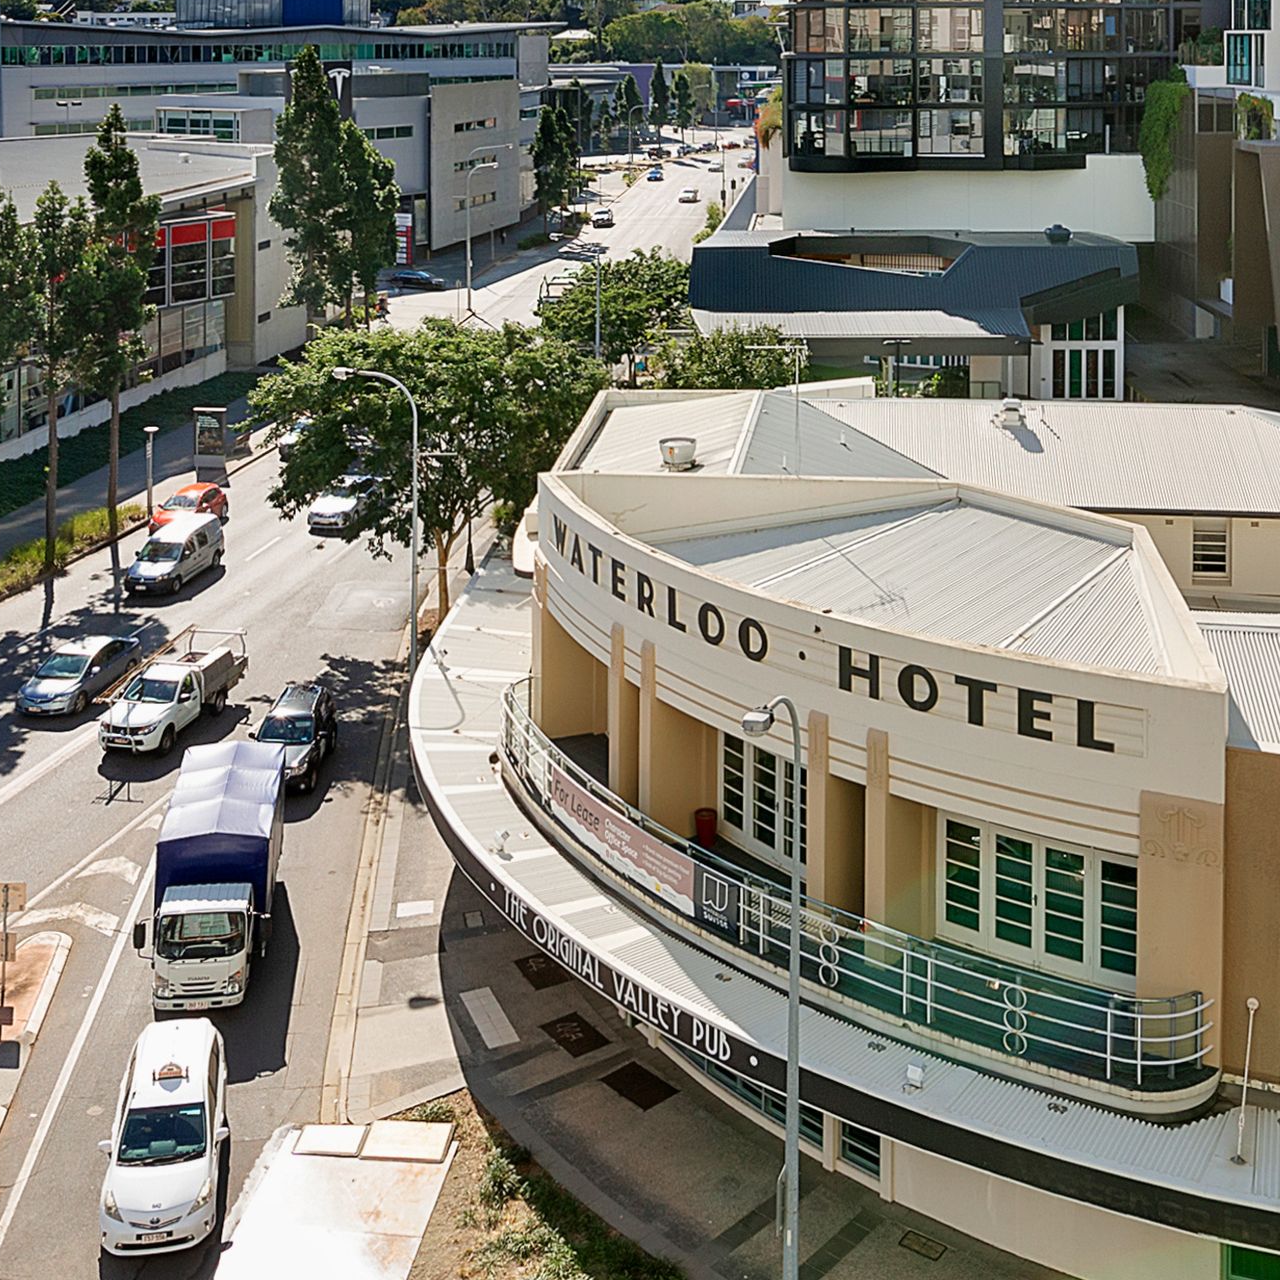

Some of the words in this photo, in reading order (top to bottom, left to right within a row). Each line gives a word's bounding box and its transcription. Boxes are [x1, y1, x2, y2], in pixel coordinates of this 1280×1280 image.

[551, 513, 768, 662] WATERLOO
[838, 646, 1115, 753] HOTEL
[554, 778, 570, 805] For
[570, 792, 600, 831] Lease
[504, 886, 528, 930] THE
[532, 915, 603, 989] ORIGINAL
[611, 971, 682, 1035] VALLEY
[692, 1016, 731, 1062] PUB
